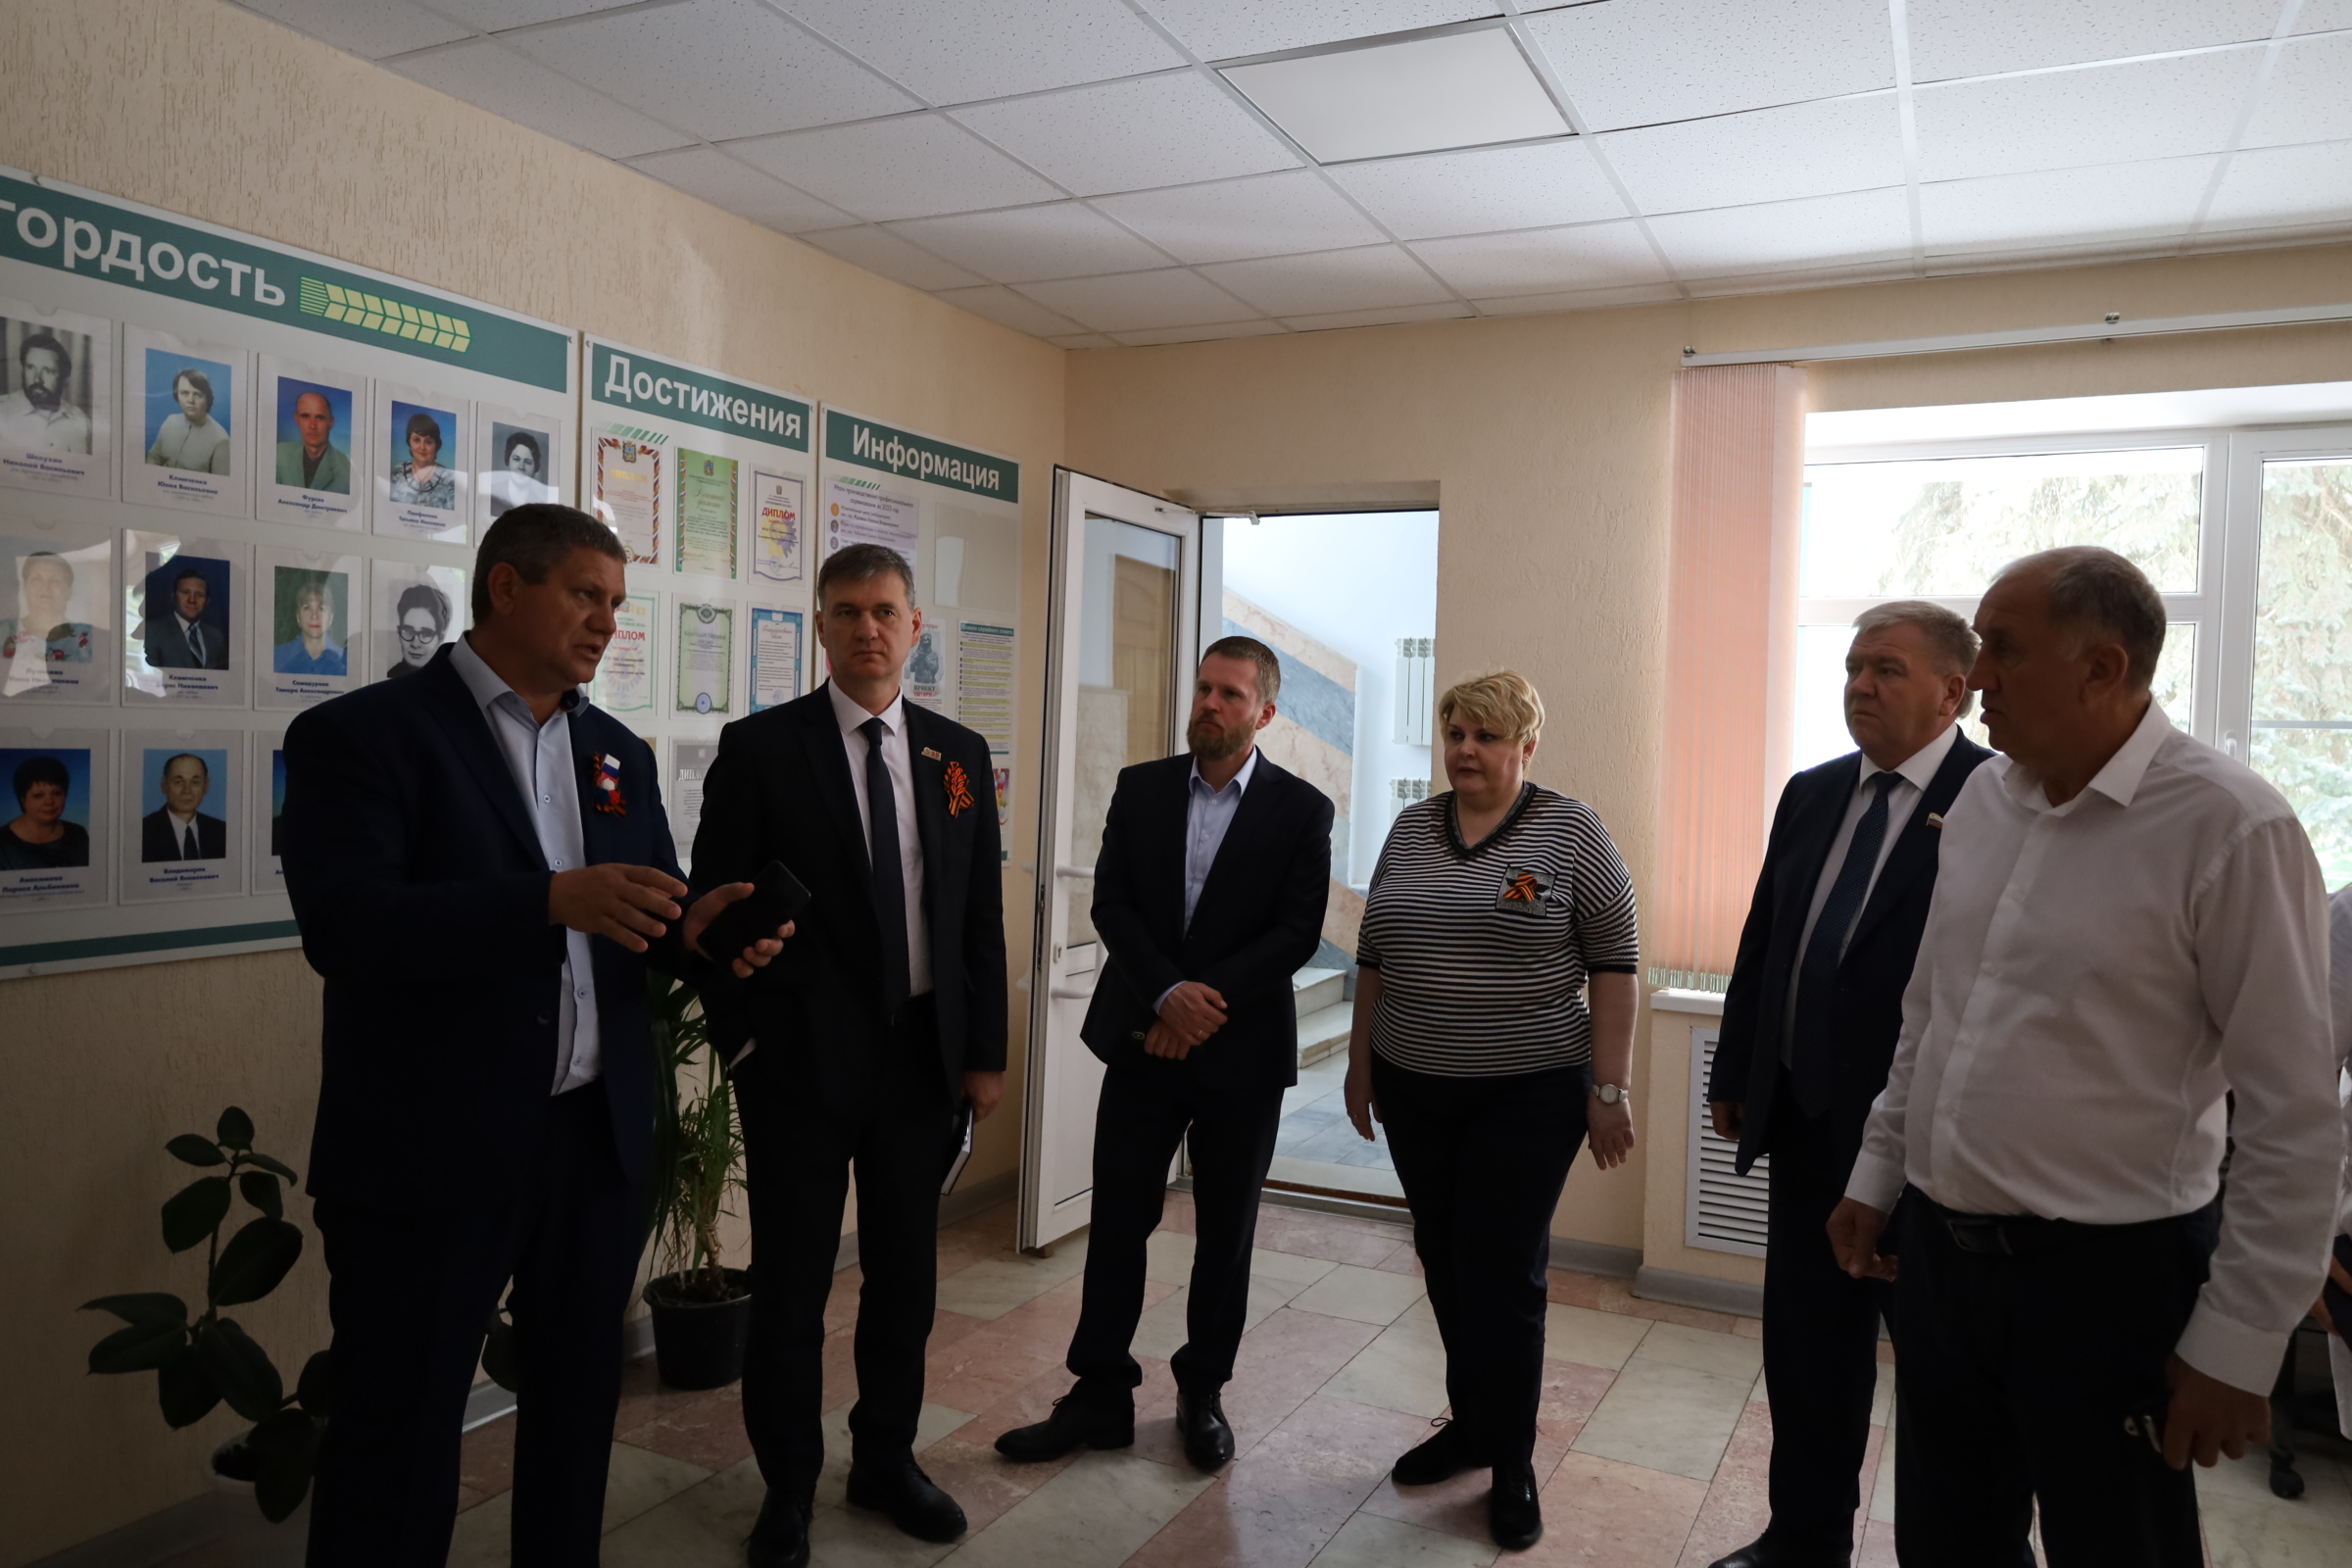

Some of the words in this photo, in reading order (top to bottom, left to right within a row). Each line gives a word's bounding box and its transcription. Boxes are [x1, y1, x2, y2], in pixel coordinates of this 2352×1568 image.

[605, 354, 801, 439] Достижения
[853, 424, 1000, 490] Информация
[3, 459, 38, 468] Николай
[40, 464, 84, 475] Васильевич
[178, 484, 218, 494] Васильевна
[277, 499, 311, 509] Александр
[312, 504, 347, 514] Дмитриевич
[761, 507, 796, 520] ДИПЛОМ
[612, 630, 645, 641] ИПЛОМ
